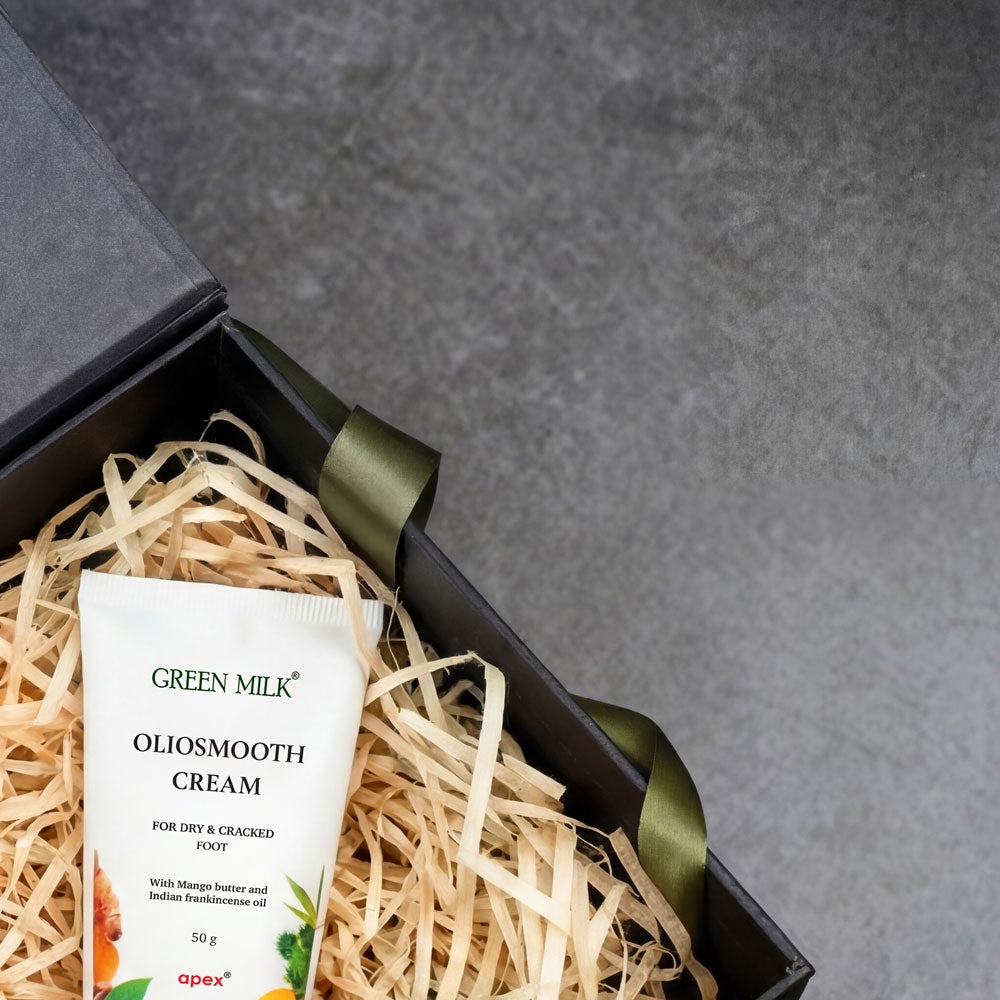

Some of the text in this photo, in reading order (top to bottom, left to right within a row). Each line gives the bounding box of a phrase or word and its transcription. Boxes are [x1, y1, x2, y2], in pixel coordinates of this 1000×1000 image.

[151, 667, 229, 693] GREEN
[133, 733, 306, 764] OLIOSMOOTH
[172, 771, 262, 796] CREAM
[152, 821, 275, 839] FOR DRY & CRACKED
[196, 841, 229, 852] FOOT
[149, 878, 268, 895] With Mango butter and
[149, 891, 267, 907] Indian frankincense oil
[191, 932, 218, 946] 50 g
